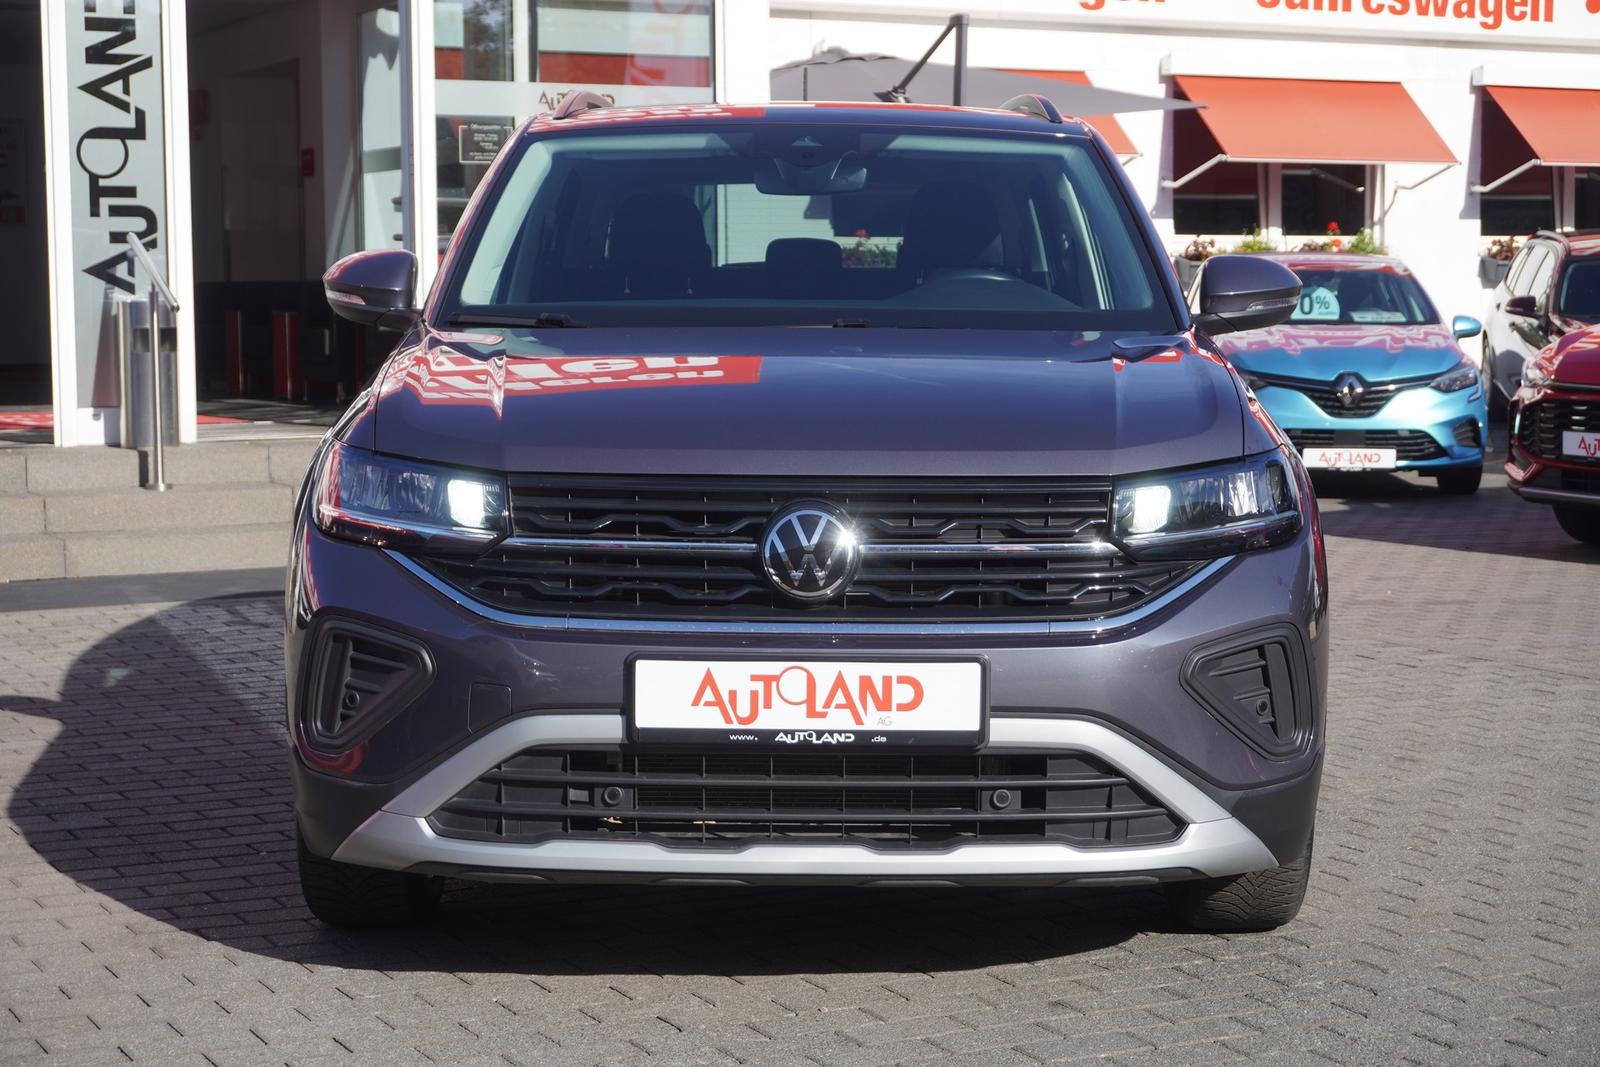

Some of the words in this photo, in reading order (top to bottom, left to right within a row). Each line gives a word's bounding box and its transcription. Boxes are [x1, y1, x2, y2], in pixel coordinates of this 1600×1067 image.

[691, 666, 924, 725] AUTOLAND
[877, 716, 893, 727] AG
[775, 731, 855, 744] AUTOLAND
